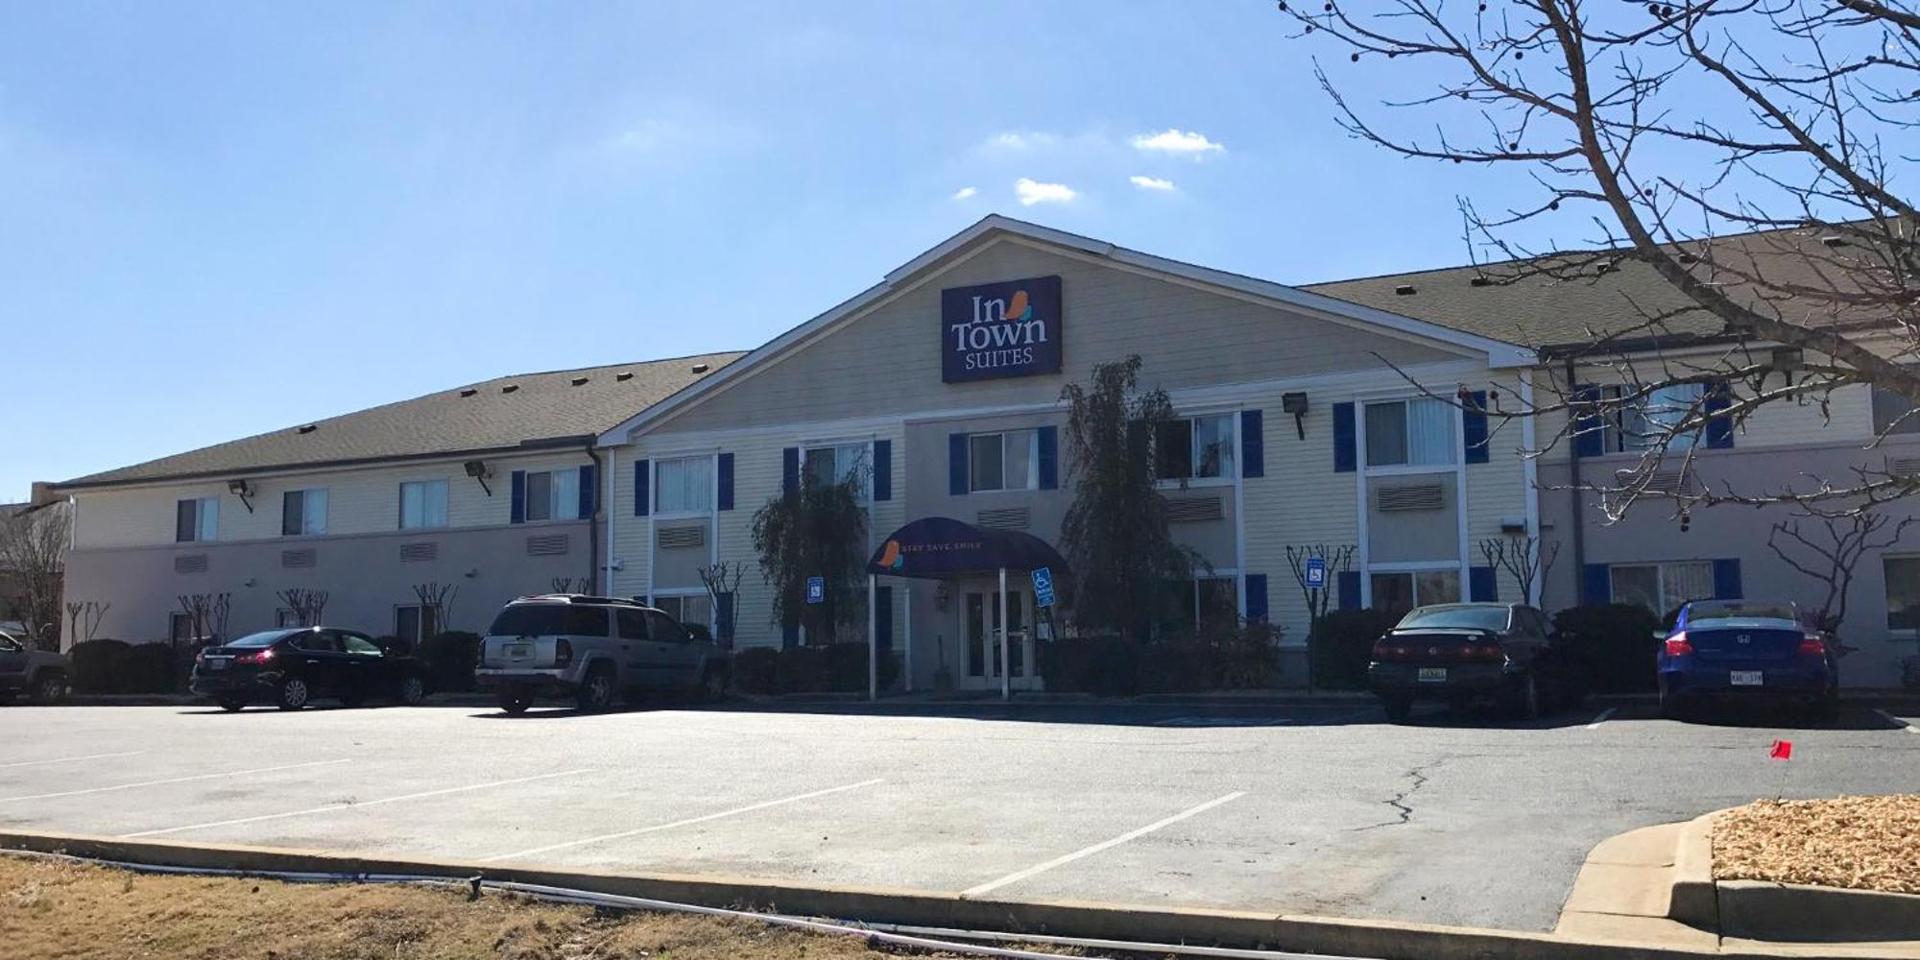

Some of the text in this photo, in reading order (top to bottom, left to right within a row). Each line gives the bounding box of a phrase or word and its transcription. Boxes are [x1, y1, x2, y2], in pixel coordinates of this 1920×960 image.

[972, 295, 1007, 324] In
[951, 319, 1048, 352] Town
[965, 346, 1033, 370] SUITES
